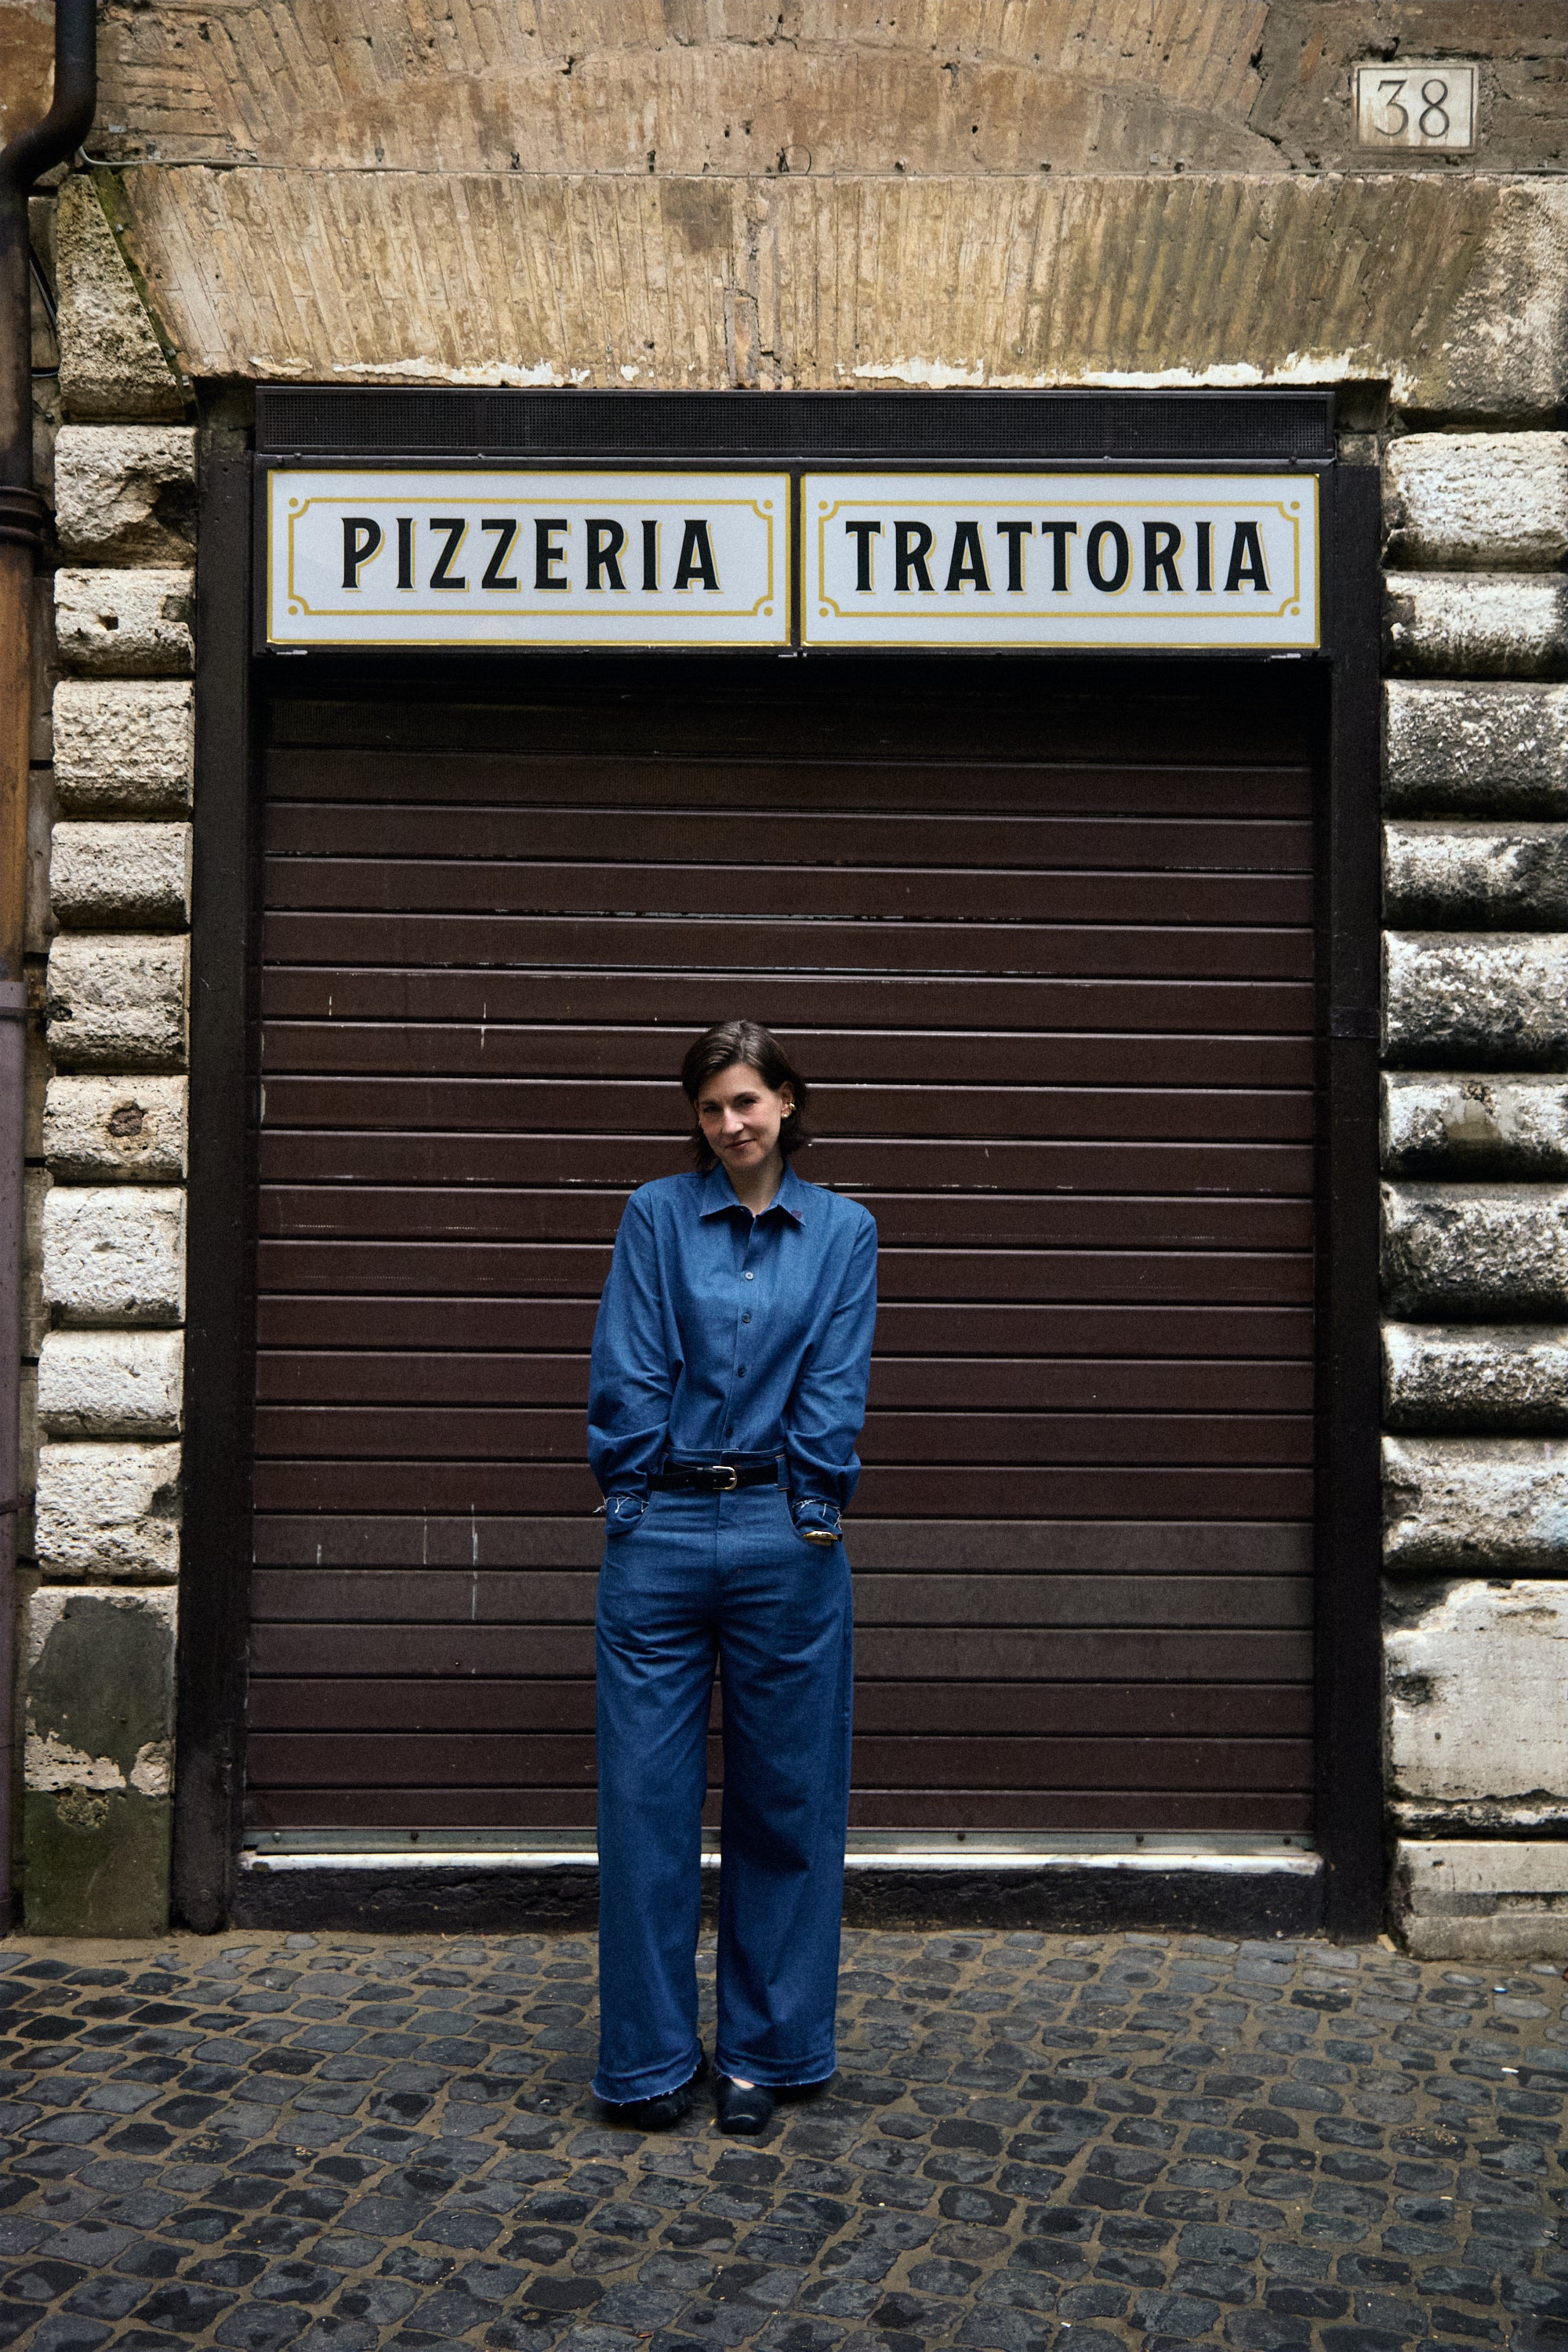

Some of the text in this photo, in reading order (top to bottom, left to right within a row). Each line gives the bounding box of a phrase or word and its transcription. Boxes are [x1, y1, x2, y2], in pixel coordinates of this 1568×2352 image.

[1376, 79, 1450, 137] 38
[341, 517, 722, 593] PIZZERIA
[845, 521, 1272, 596] TRATTORIA
